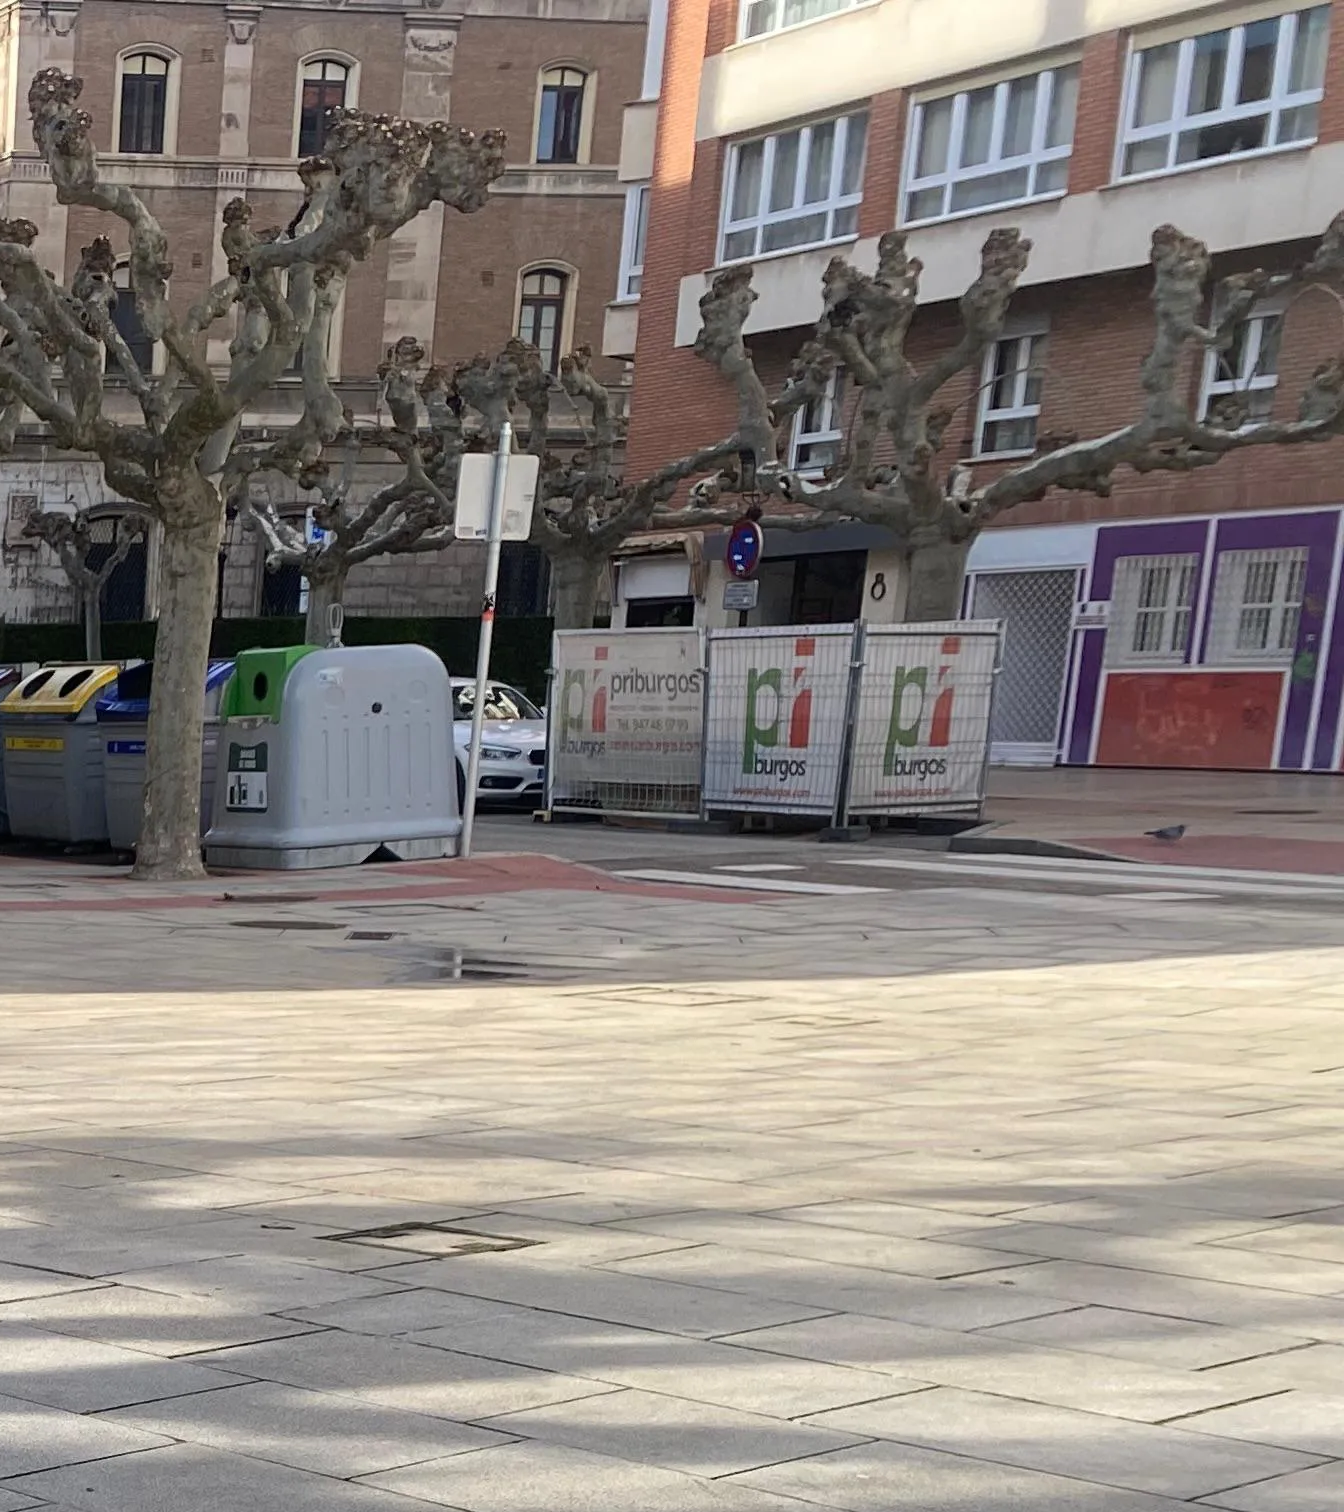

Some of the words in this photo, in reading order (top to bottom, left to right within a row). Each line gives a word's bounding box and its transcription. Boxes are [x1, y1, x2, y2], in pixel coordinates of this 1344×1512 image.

[610, 667, 701, 701] priburgos
[754, 754, 807, 782] burgos
[894, 757, 947, 781] burgos
